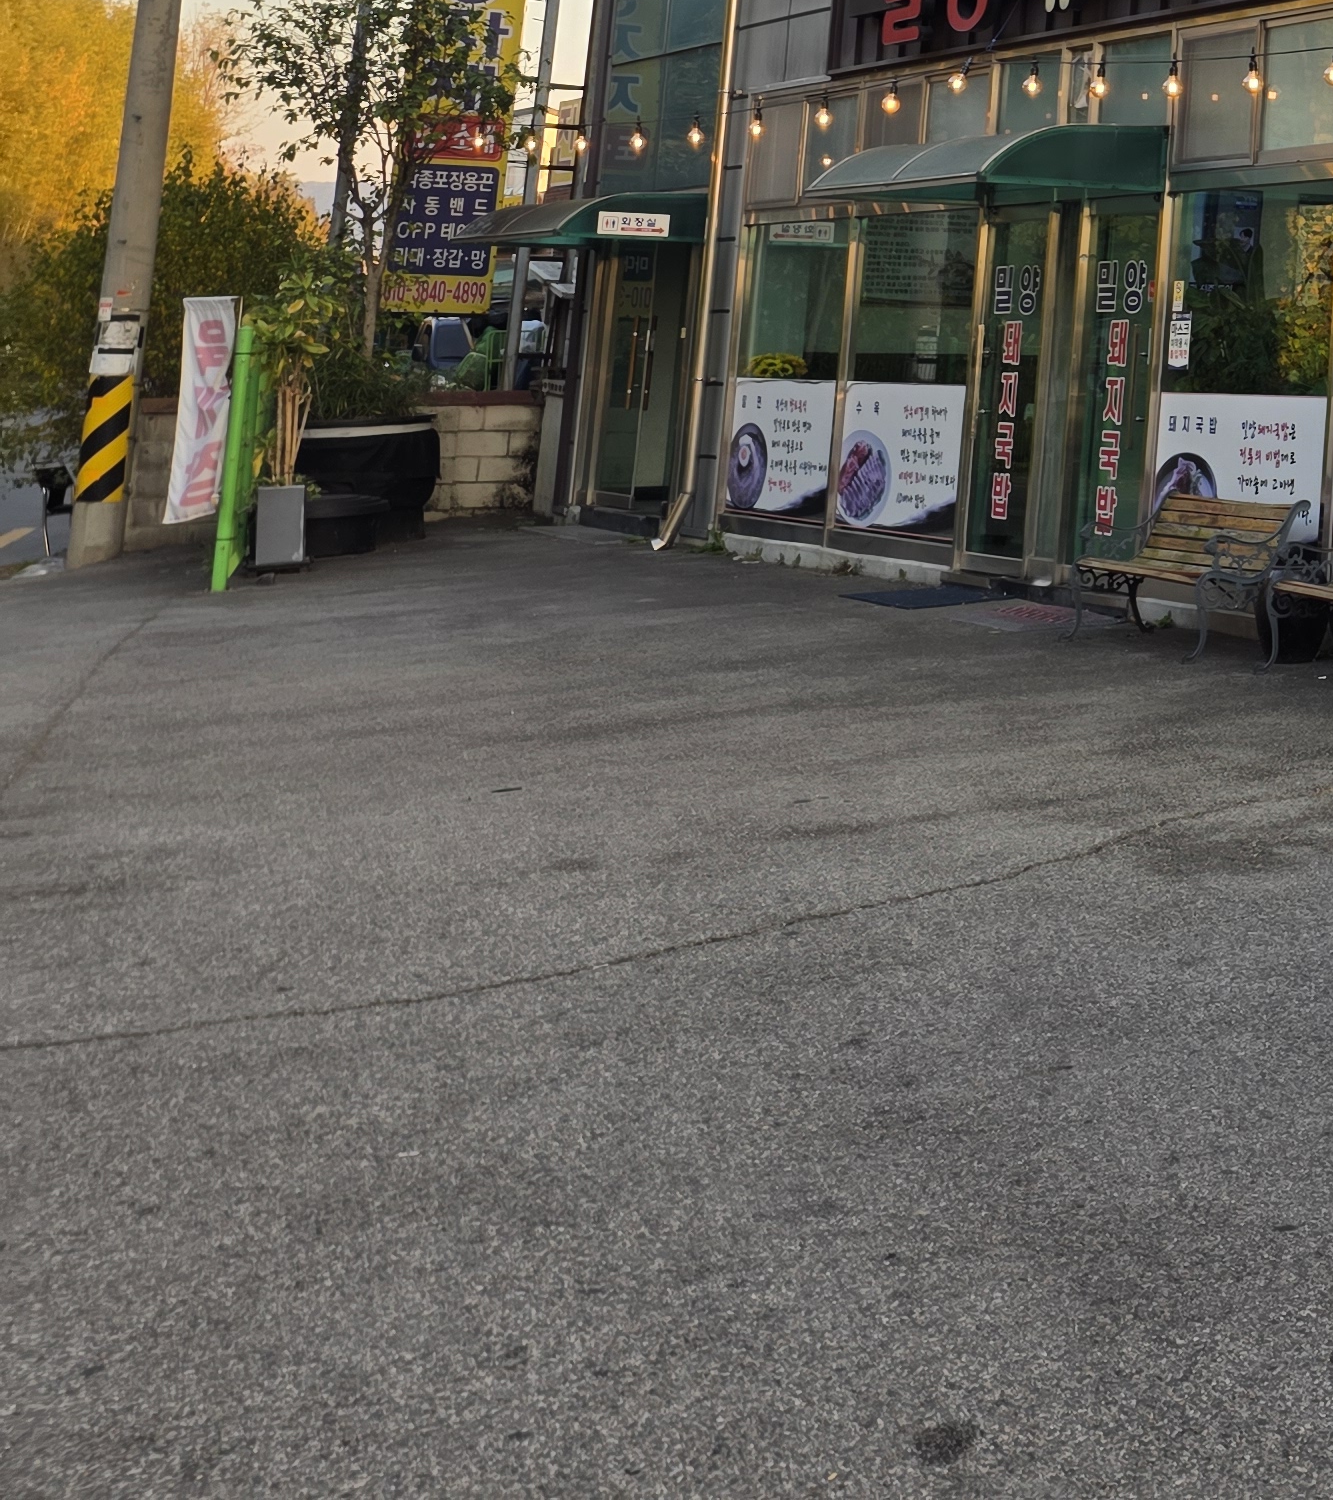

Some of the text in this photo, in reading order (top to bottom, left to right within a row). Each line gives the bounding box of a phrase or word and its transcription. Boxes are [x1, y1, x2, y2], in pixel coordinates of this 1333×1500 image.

[993, 264, 1041, 316] 밀양
[1095, 259, 1148, 315] 밀양
[855, 400, 881, 416] 수육
[991, 319, 1023, 521] 돼지국밥
[1094, 319, 1130, 537] 돼지국밥
[1168, 415, 1218, 435] 돼지국밥
